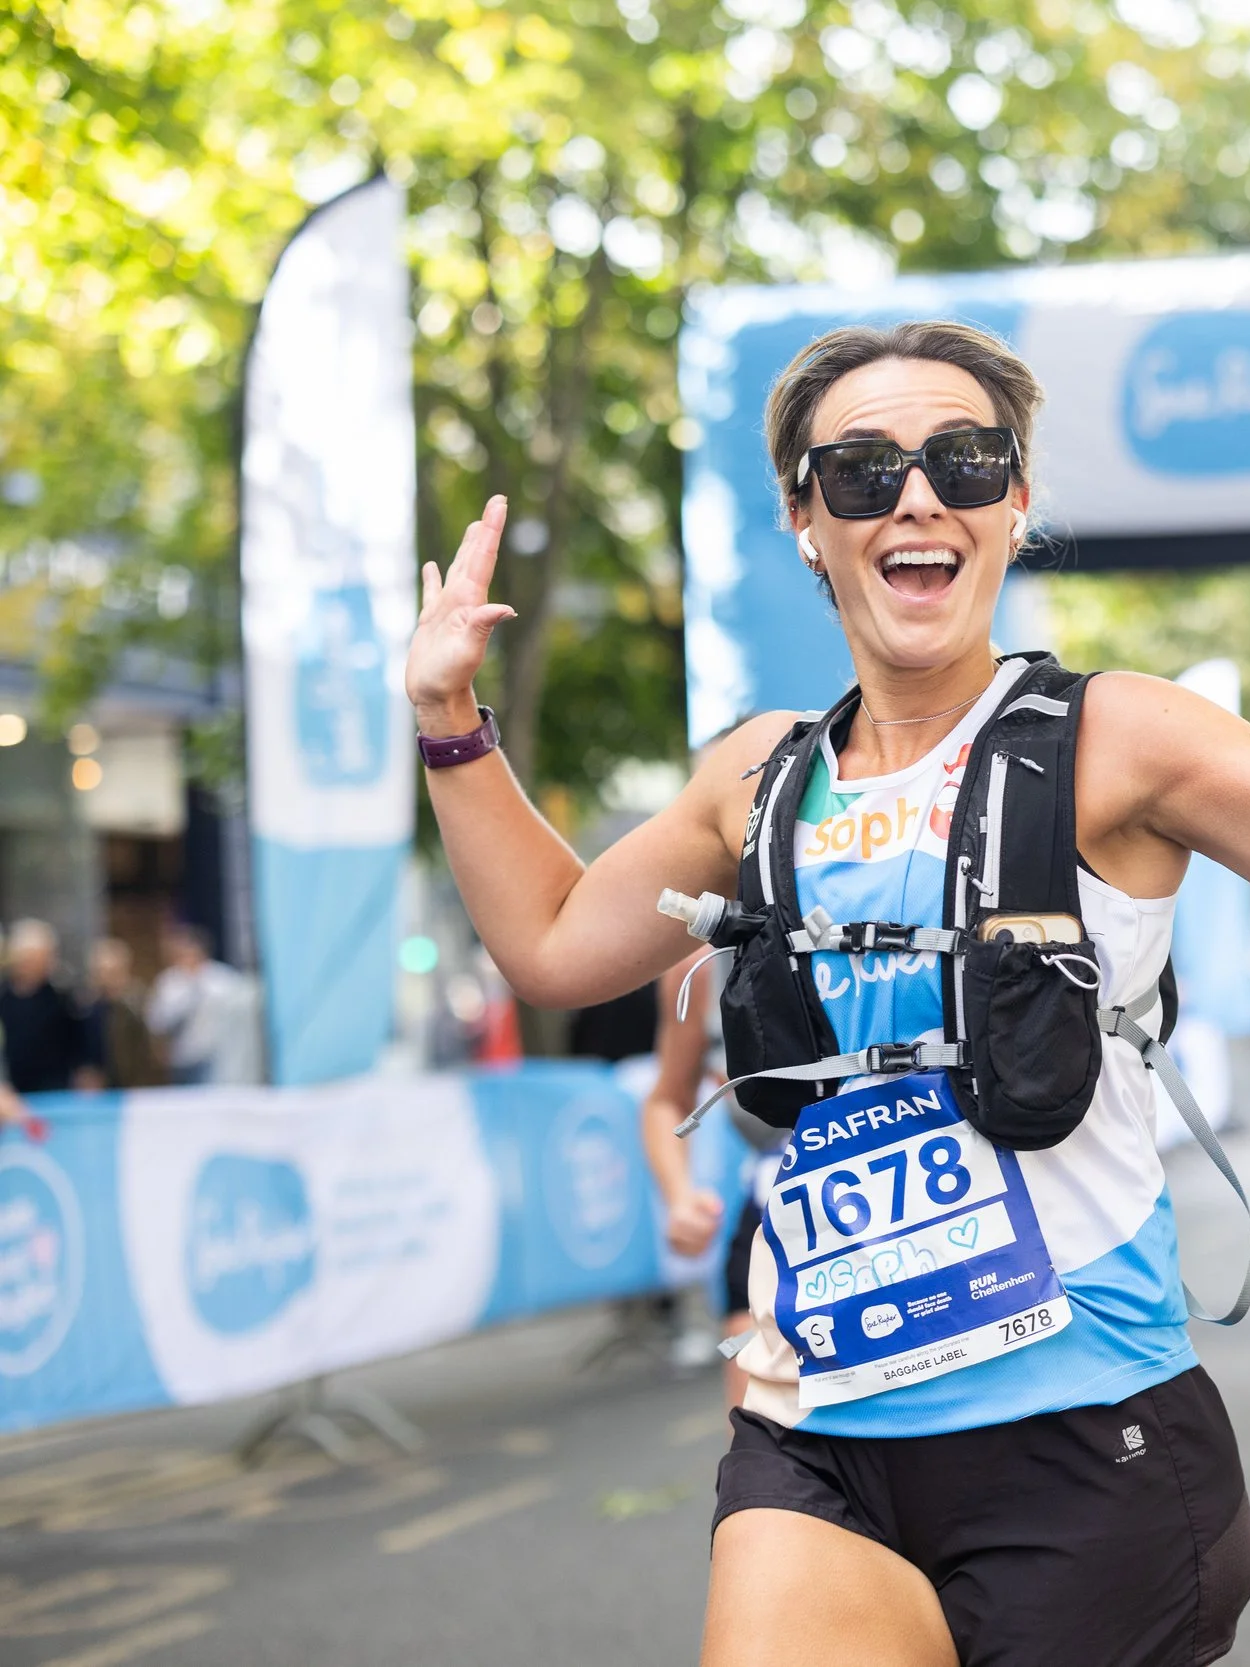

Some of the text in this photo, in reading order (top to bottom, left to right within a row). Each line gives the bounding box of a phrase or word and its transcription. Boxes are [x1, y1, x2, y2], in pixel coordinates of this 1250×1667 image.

[801, 1089, 942, 1151] SAFRAN
[780, 1135, 971, 1252] 7678
[969, 1272, 997, 1292] RUN
[971, 1272, 1036, 1300] Cheltenham
[998, 1308, 1052, 1342] 7678
[883, 1348, 968, 1381] BAGGAGE LABEL
